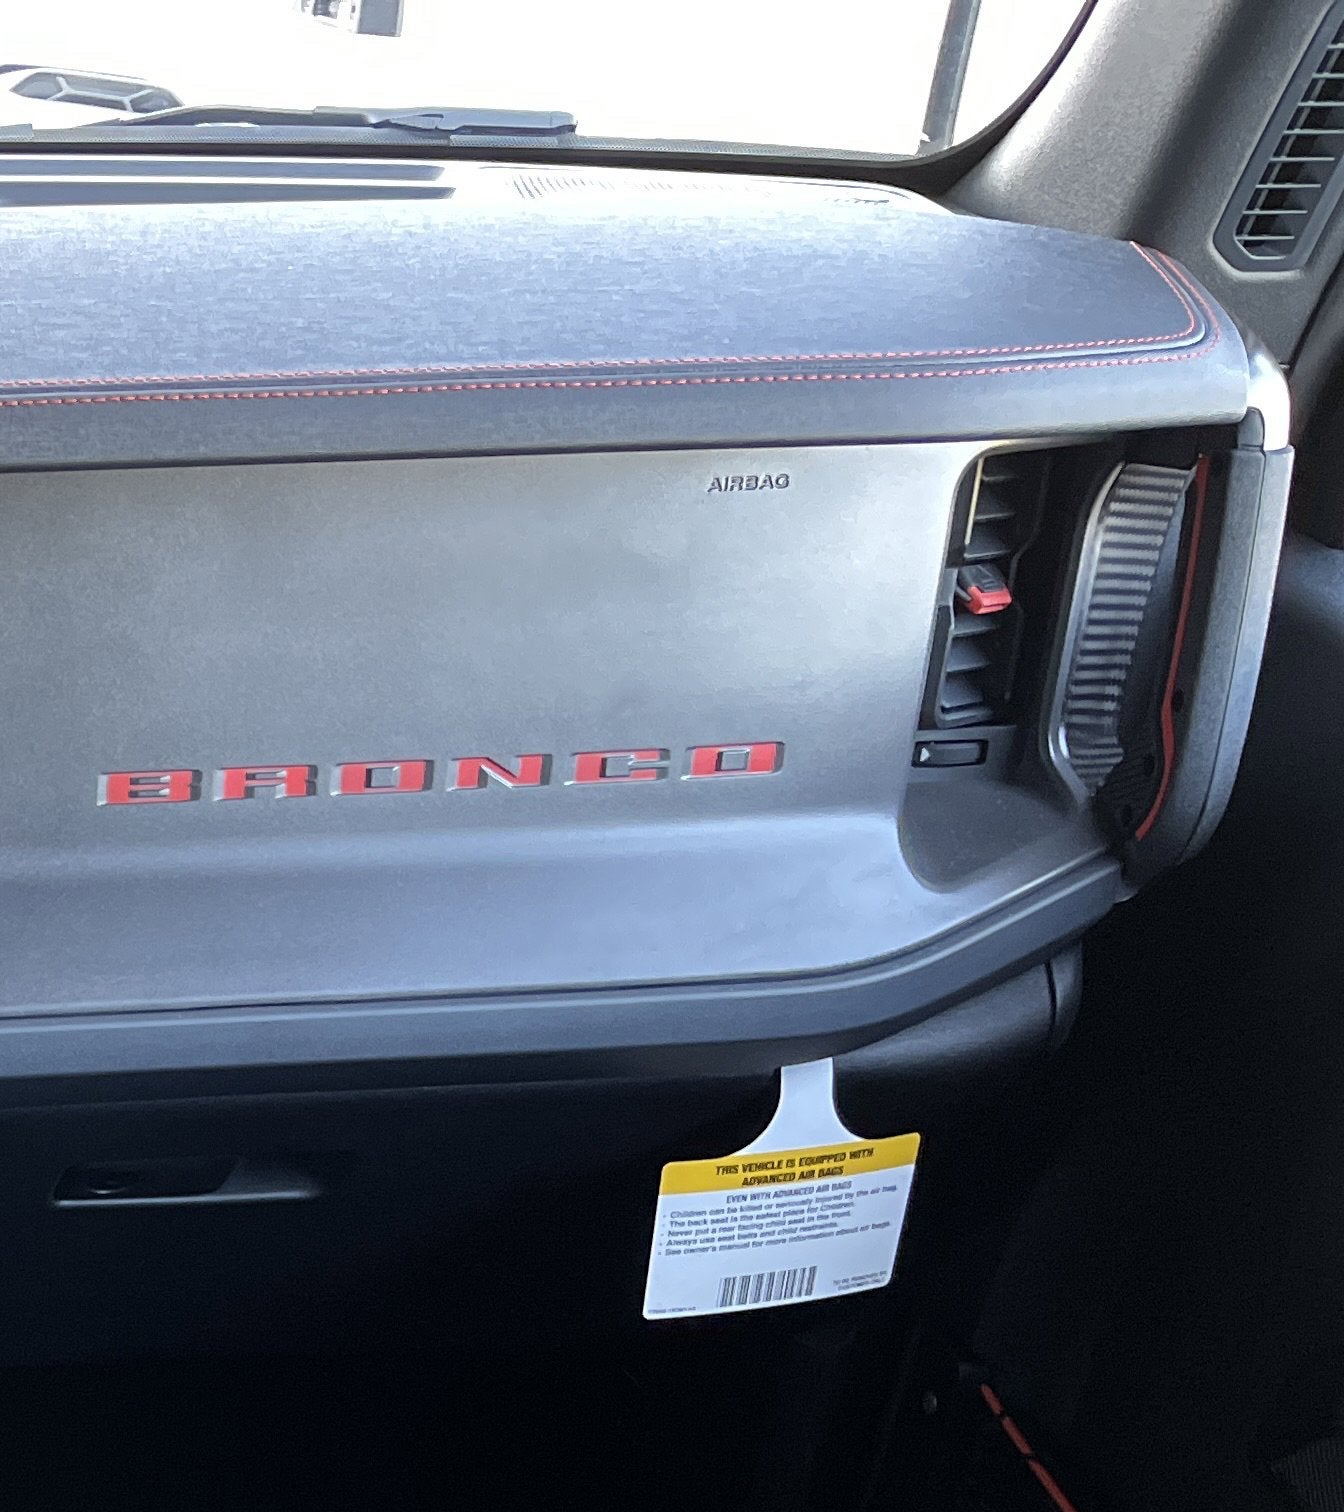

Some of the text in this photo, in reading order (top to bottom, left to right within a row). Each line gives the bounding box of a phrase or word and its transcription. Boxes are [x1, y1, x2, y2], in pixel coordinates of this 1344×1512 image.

[707, 473, 791, 493] AIRBAG
[96, 740, 786, 806] BRONCO
[716, 1147, 874, 1176] THIS VEHICLE IS EQUIPPED WITH
[742, 1166, 844, 1186] ADVANCED AIR BAGS
[726, 1180, 852, 1204] EVEN WITH ADVANCED AIR BAGS
